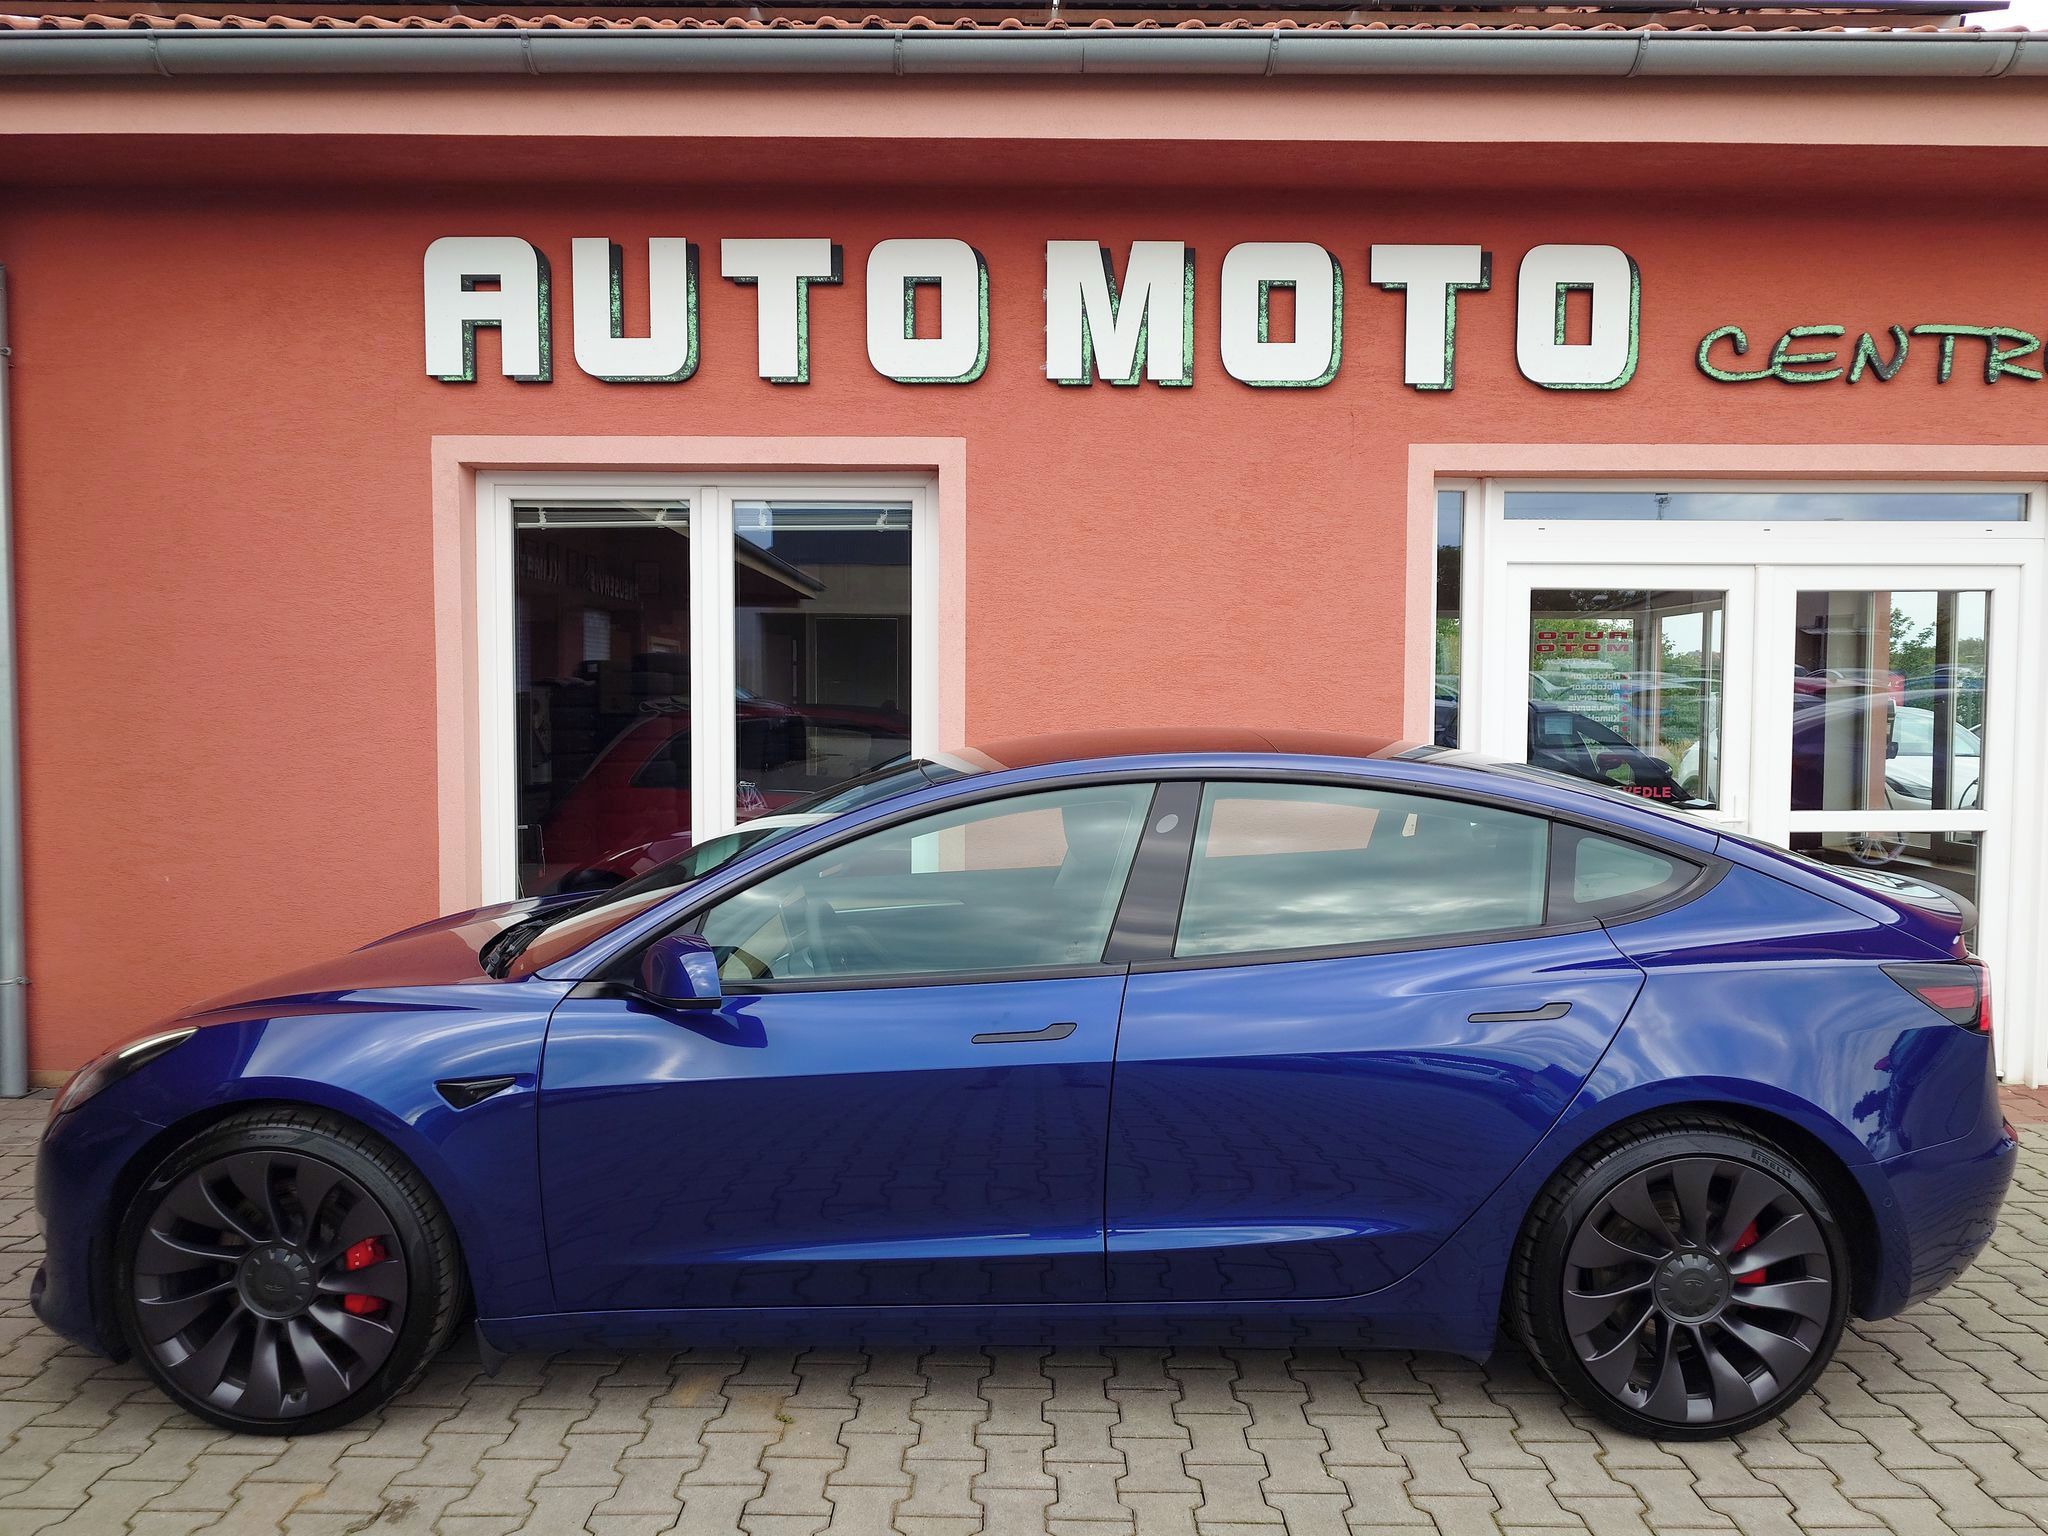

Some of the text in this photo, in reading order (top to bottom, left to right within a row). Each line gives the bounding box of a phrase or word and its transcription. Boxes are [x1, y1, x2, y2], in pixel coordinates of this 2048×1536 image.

[423, 236, 2048, 390] AUTO MOTO CENTR
